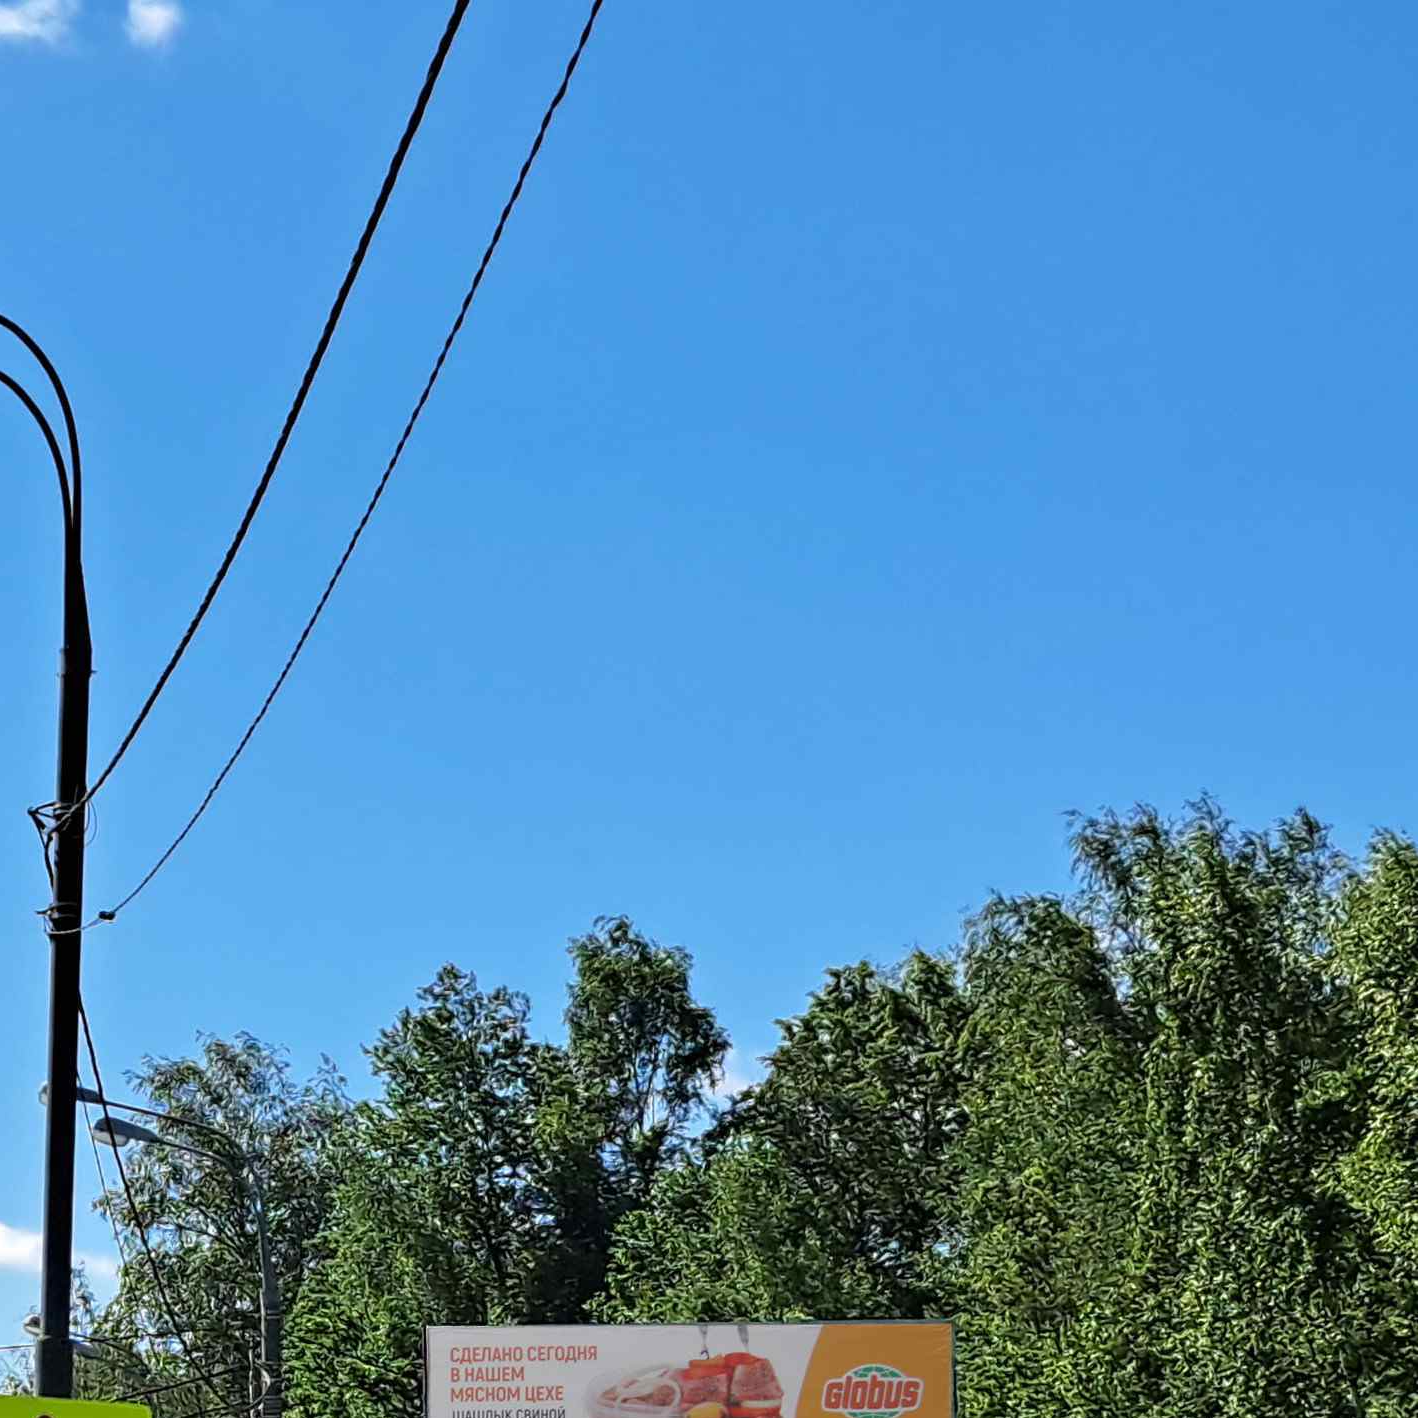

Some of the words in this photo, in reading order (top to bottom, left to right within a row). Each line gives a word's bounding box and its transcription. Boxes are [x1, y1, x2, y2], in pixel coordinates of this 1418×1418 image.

[450, 1347, 523, 1364] СДЕЛАНО
[527, 1345, 598, 1363] СЕГОДНЯ
[450, 1367, 460, 1382] В
[465, 1366, 525, 1382] НАШЕМ
[450, 1386, 521, 1402] МЯСНОМ
[525, 1385, 564, 1403] ЦЕХЕ
